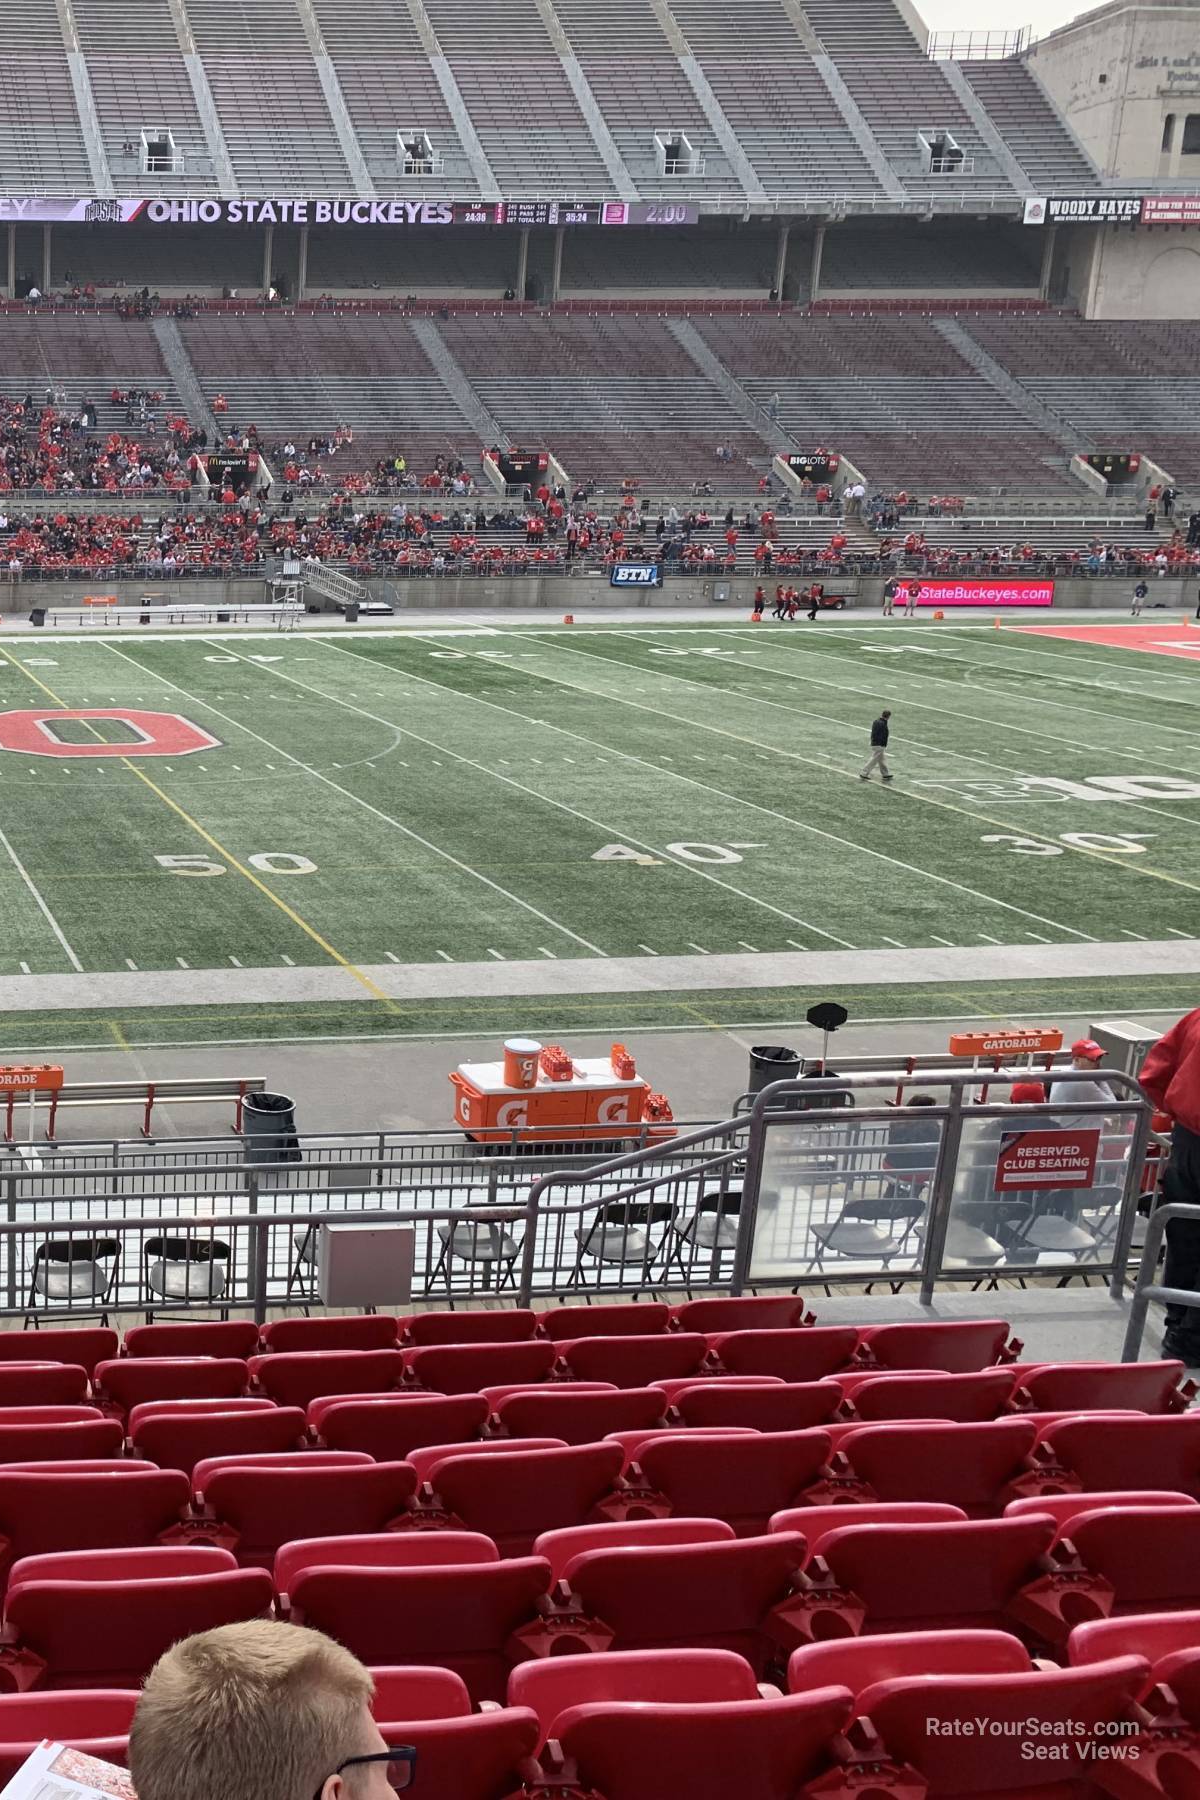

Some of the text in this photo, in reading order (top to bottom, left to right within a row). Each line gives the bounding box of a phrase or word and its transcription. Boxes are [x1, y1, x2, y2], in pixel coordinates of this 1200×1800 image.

[147, 202, 453, 223] OHIO STATE BUCKEYES
[646, 205, 687, 222] 2:00
[1050, 200, 1141, 215] WOODY HAYES
[565, 212, 588, 222] 35:24
[789, 456, 806, 465] BIG
[806, 456, 826, 465] LOTS
[615, 568, 652, 581] BTN
[894, 586, 1050, 602] OhStateBuckeyes.com
[979, 832, 1147, 856] 30
[590, 842, 744, 865] 40
[153, 852, 318, 877] 50
[982, 1038, 1042, 1050] GATORADE
[522, 1060, 534, 1071] G
[460, 1096, 471, 1122] G
[496, 1099, 529, 1128] G
[597, 1094, 630, 1124] G
[1017, 1146, 1080, 1157] RESERVED
[1003, 1157, 1090, 1170] CLUB SEATING
